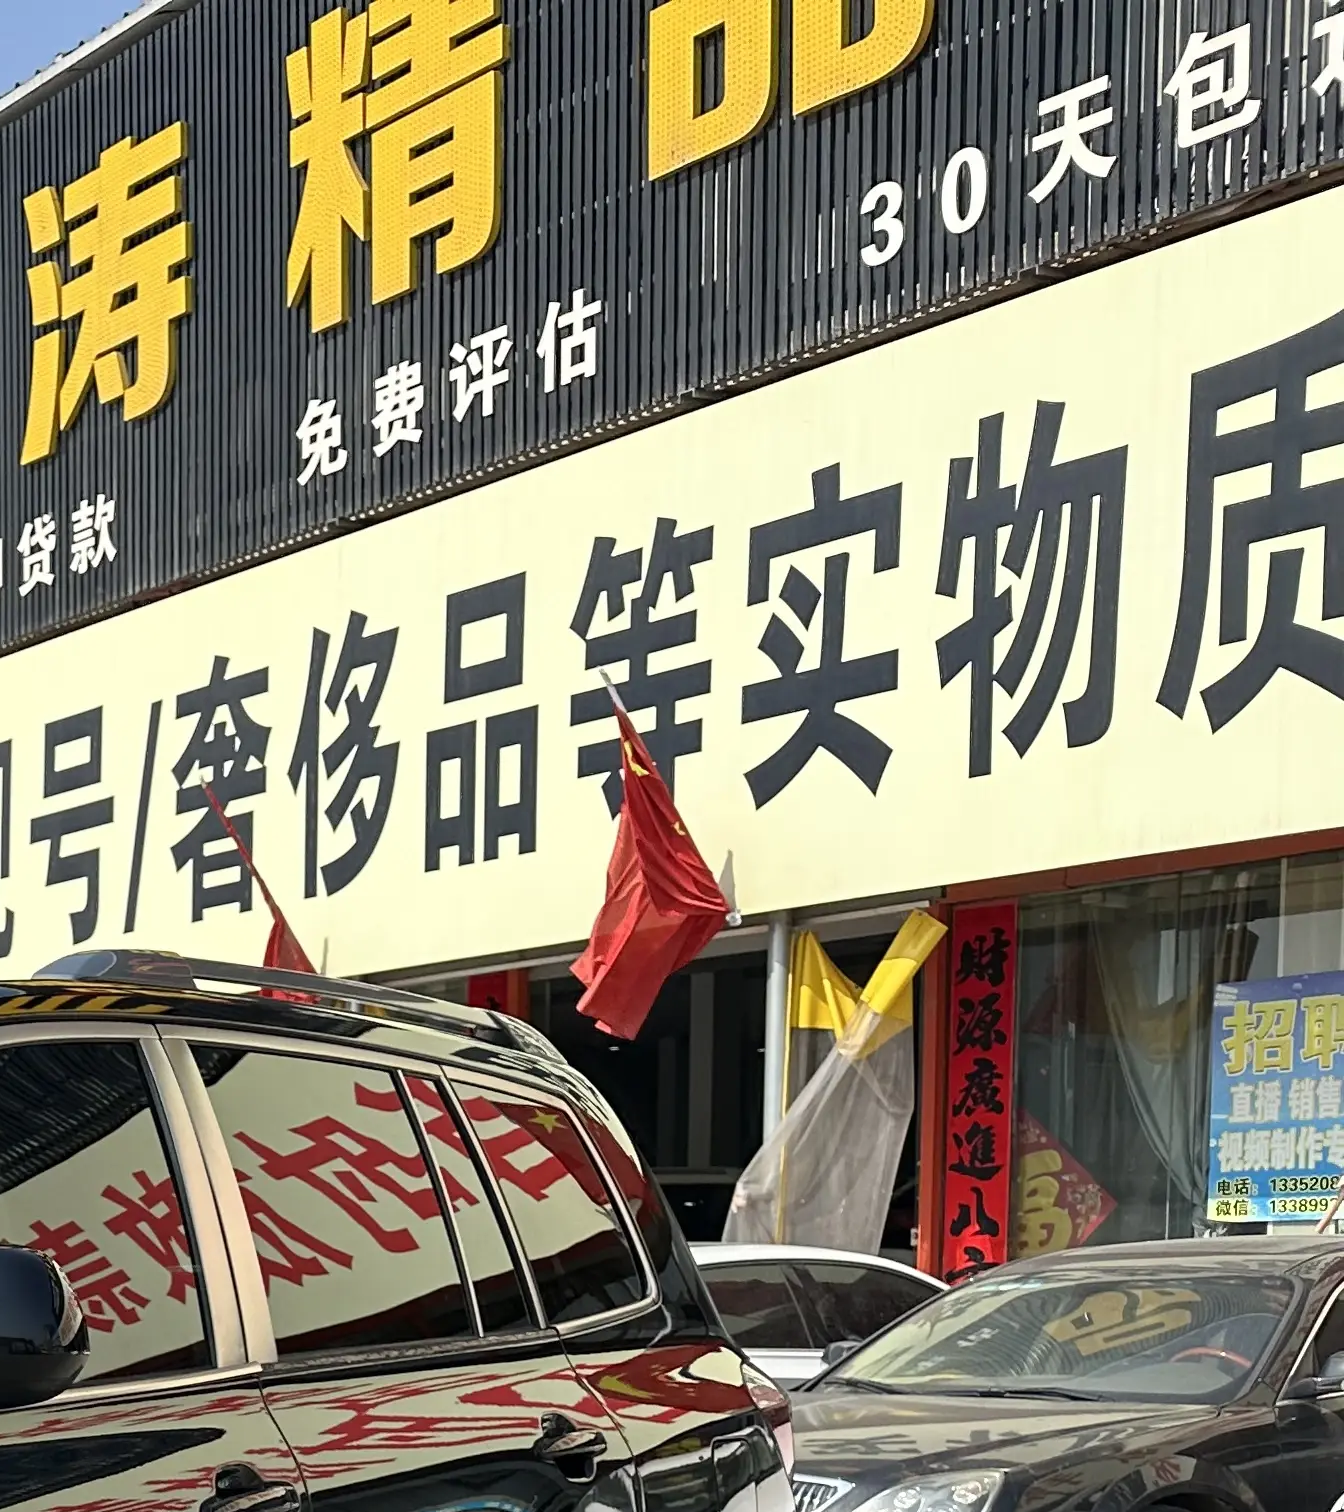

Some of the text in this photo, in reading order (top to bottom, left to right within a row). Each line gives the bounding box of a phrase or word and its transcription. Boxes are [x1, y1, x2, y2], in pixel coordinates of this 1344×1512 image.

[295, 286, 603, 487] 免费评估
[858, 2, 1344, 267] 30天包
[1229, 1075, 1343, 1123] 直播 销售
